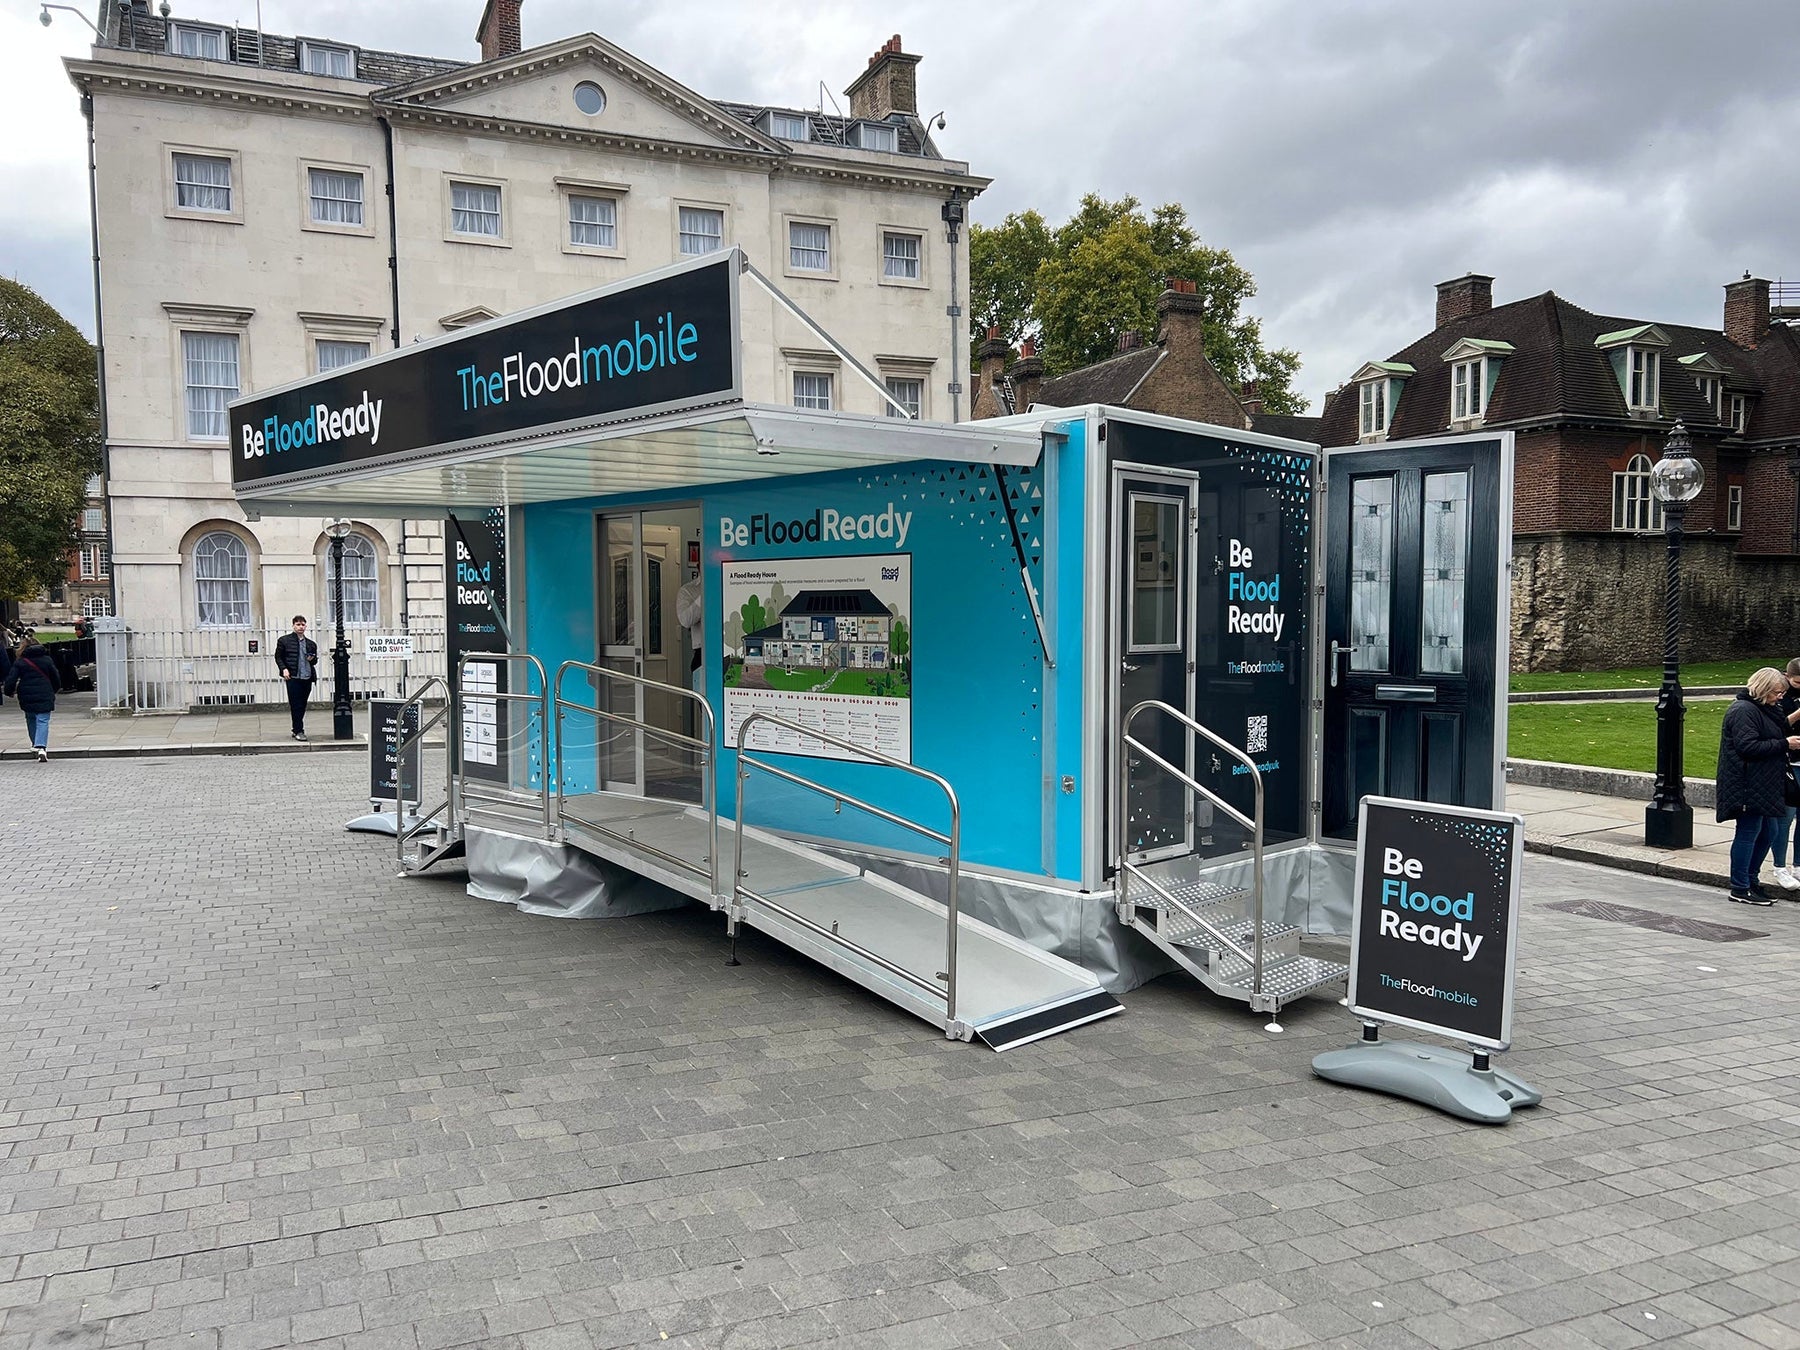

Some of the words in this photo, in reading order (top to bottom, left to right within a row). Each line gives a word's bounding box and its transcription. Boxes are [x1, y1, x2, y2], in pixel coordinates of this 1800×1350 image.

[456, 311, 698, 411] TheFloodmobile
[242, 390, 383, 460] BeFloodReady
[720, 502, 912, 549] BeFloodReady
[1229, 539, 1253, 568] Be
[747, 571, 761, 580] Ready
[881, 567, 899, 575] flood
[881, 574, 899, 582] mary
[1229, 572, 1280, 601] Flood
[458, 623, 496, 633] TheFloodmobile
[1228, 605, 1285, 641] Ready
[370, 638, 383, 646] OLD
[1228, 661, 1284, 674] TheFloodmobile
[385, 754, 405, 766] Reay
[1382, 847, 1424, 879] Be
[1381, 878, 1475, 921] Flood
[1379, 908, 1484, 962] Ready
[1380, 973, 1478, 1007] TheFloodmobile
